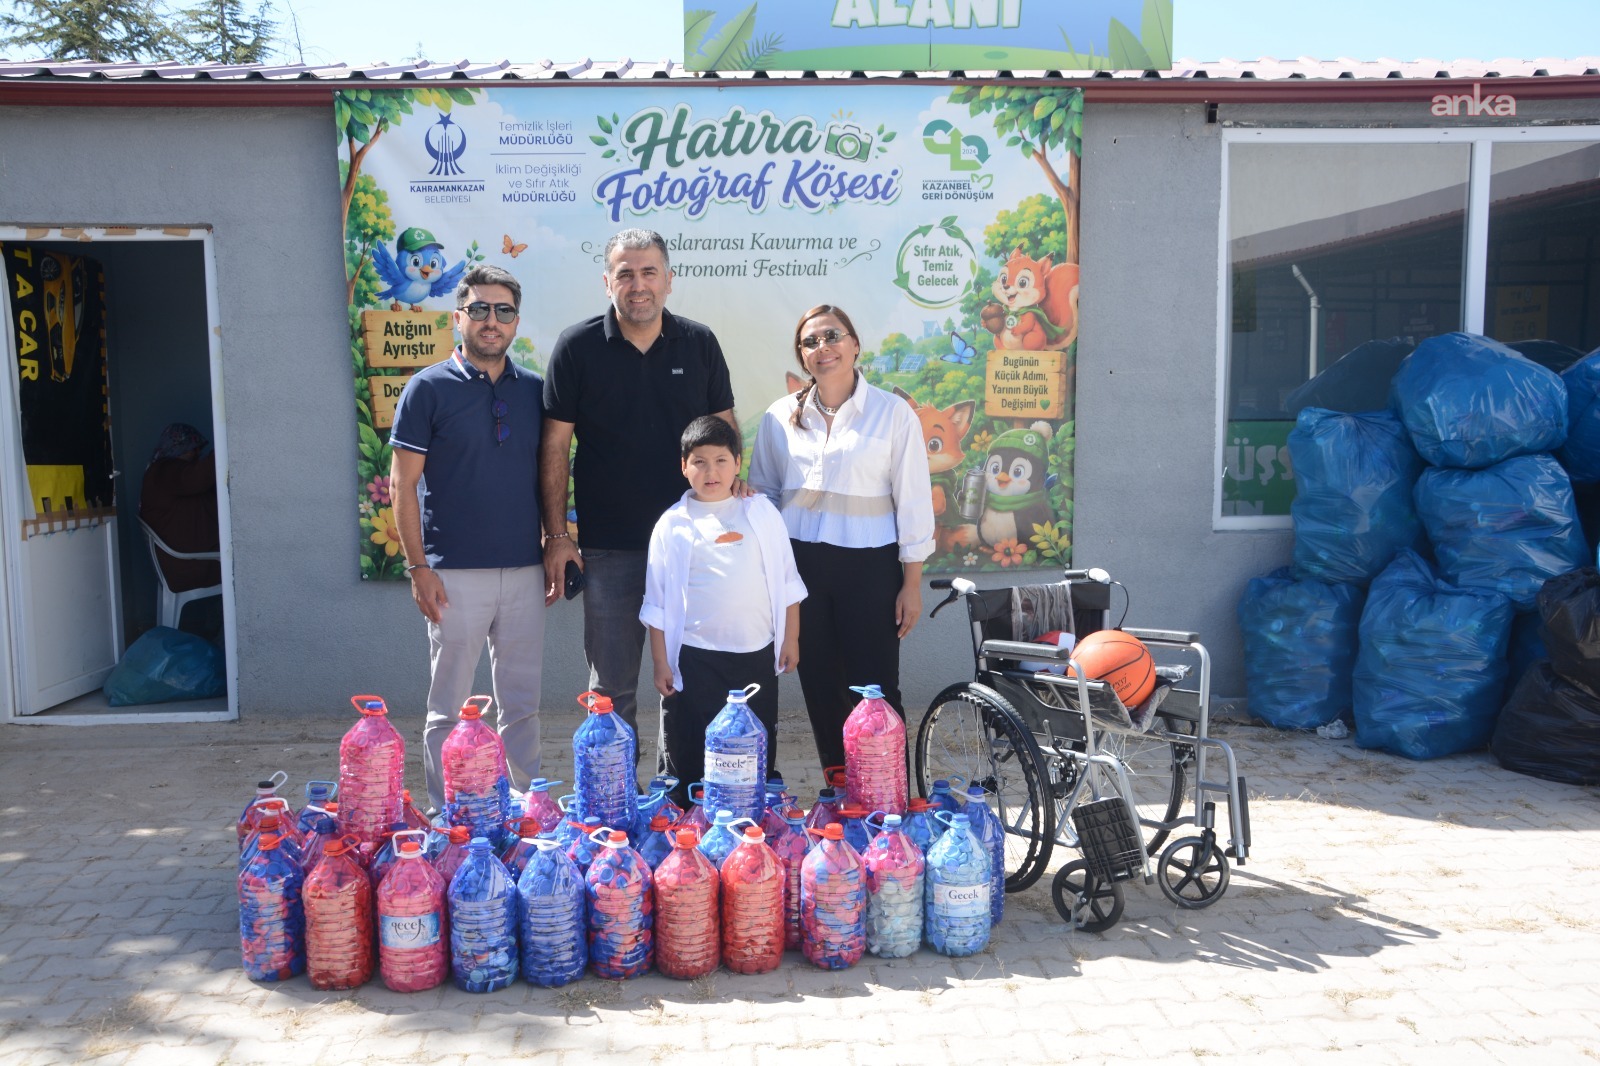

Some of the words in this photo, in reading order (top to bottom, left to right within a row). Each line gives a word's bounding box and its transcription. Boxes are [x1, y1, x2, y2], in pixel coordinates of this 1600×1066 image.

[831, 0, 1022, 28] ALANI
[499, 121, 543, 131] Temizlik
[546, 120, 572, 134] İşleri
[499, 134, 573, 145] MÜDÜRLÜĞÜ
[625, 107, 822, 171] Hatıra
[495, 163, 522, 174] İklim
[525, 164, 582, 177] Değişikliği
[410, 184, 485, 193] KAHRAMANKAZAN
[525, 178, 546, 188] Sıfır
[549, 178, 570, 188] Atık
[922, 182, 972, 191] KAZANBEL
[502, 191, 576, 202] MÜDÜRLÜĞÜ
[596, 161, 776, 222] Fotoğraf
[782, 159, 899, 208] Köşesi
[922, 191, 943, 200] GERİ
[944, 190, 994, 203] DÖNÜŞÜM
[424, 195, 471, 203] BELEDİYESİ
[750, 232, 833, 250] Kavurma
[838, 237, 857, 249] ve
[913, 244, 936, 257] Sıfır
[938, 244, 963, 258] Atık,
[753, 258, 828, 278] Festivali
[922, 260, 953, 272] Temiz
[16, 273, 34, 299] A
[917, 274, 959, 286] Gelecek
[383, 320, 432, 340] Atığını
[20, 310, 39, 381] CAR
[383, 341, 435, 359] Ayrıştır
[1003, 356, 1039, 368] Bugünün
[994, 370, 1020, 382] Küçük
[1022, 371, 1048, 382] Adımı,
[992, 384, 1021, 395] Yarının
[1023, 384, 1048, 397] Büyük
[1001, 398, 1037, 411] Değişimi
[948, 889, 979, 900] Gecek
